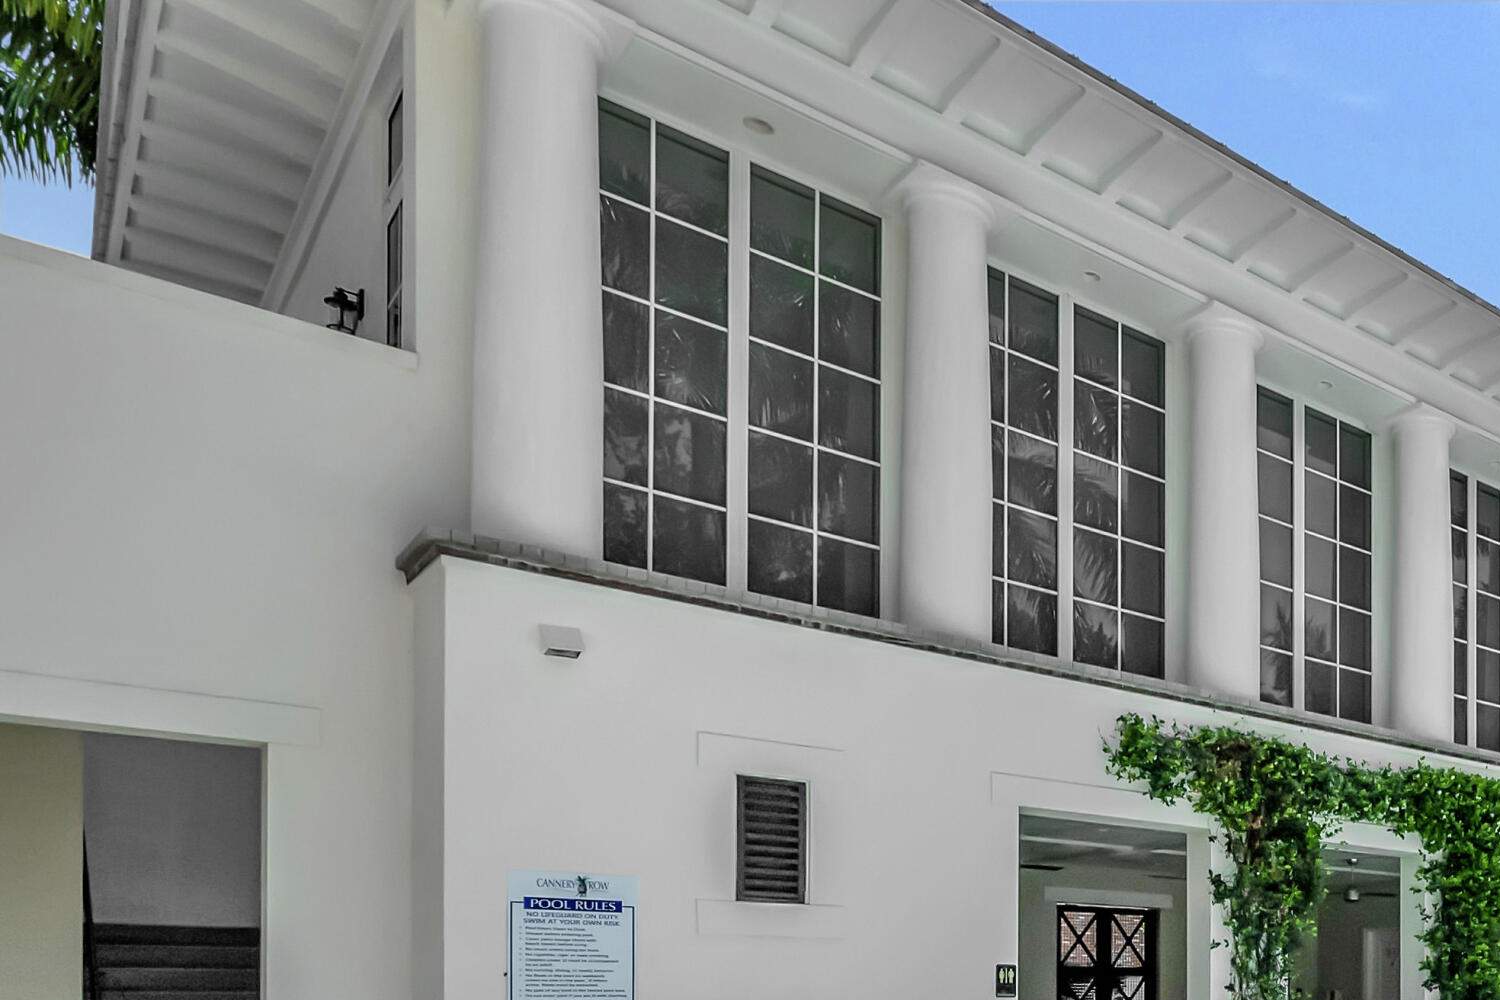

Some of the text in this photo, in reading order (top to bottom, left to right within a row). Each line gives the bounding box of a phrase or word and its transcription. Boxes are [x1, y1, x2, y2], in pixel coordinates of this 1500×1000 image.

[536, 878, 610, 890] CANNERY ROW
[530, 899, 616, 911] POOL RULES
[540, 911, 582, 919] LIFEGUARD
